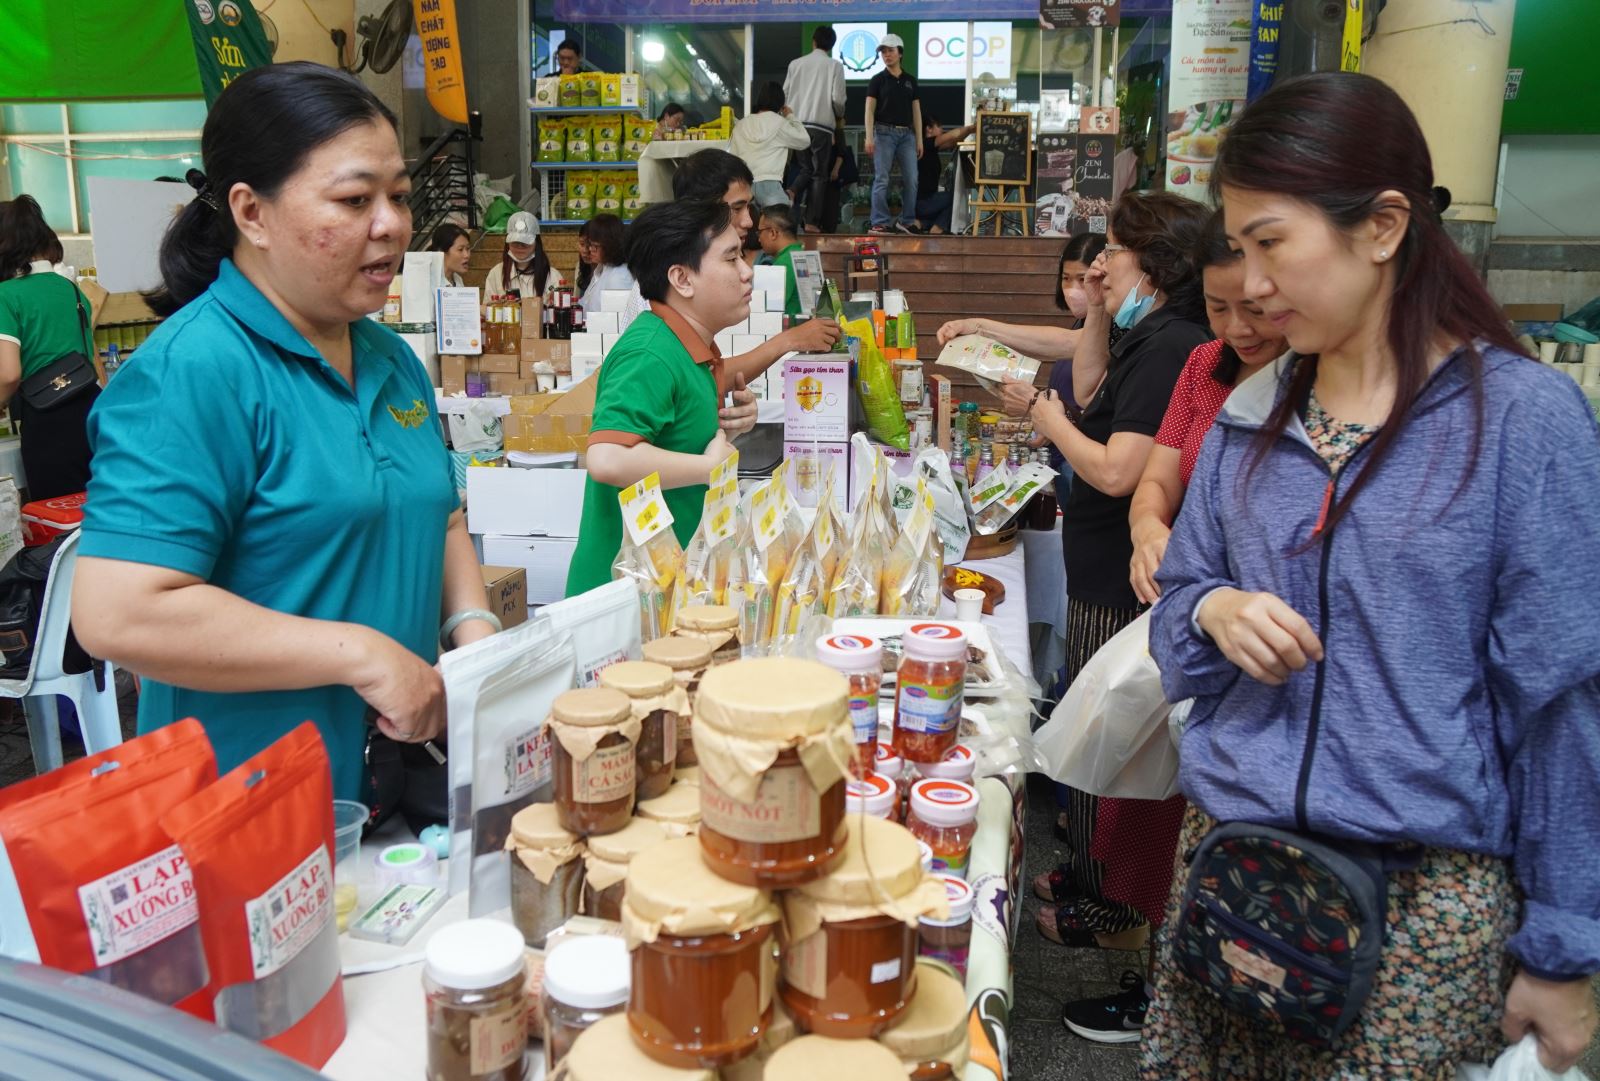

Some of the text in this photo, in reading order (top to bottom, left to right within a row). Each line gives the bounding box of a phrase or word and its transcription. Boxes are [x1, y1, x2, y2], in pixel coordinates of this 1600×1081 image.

[925, 37, 1006, 58] OCOP
[1074, 165, 1111, 183] Chocolate
[132, 856, 185, 894] LẠP
[181, 880, 193, 899] B
